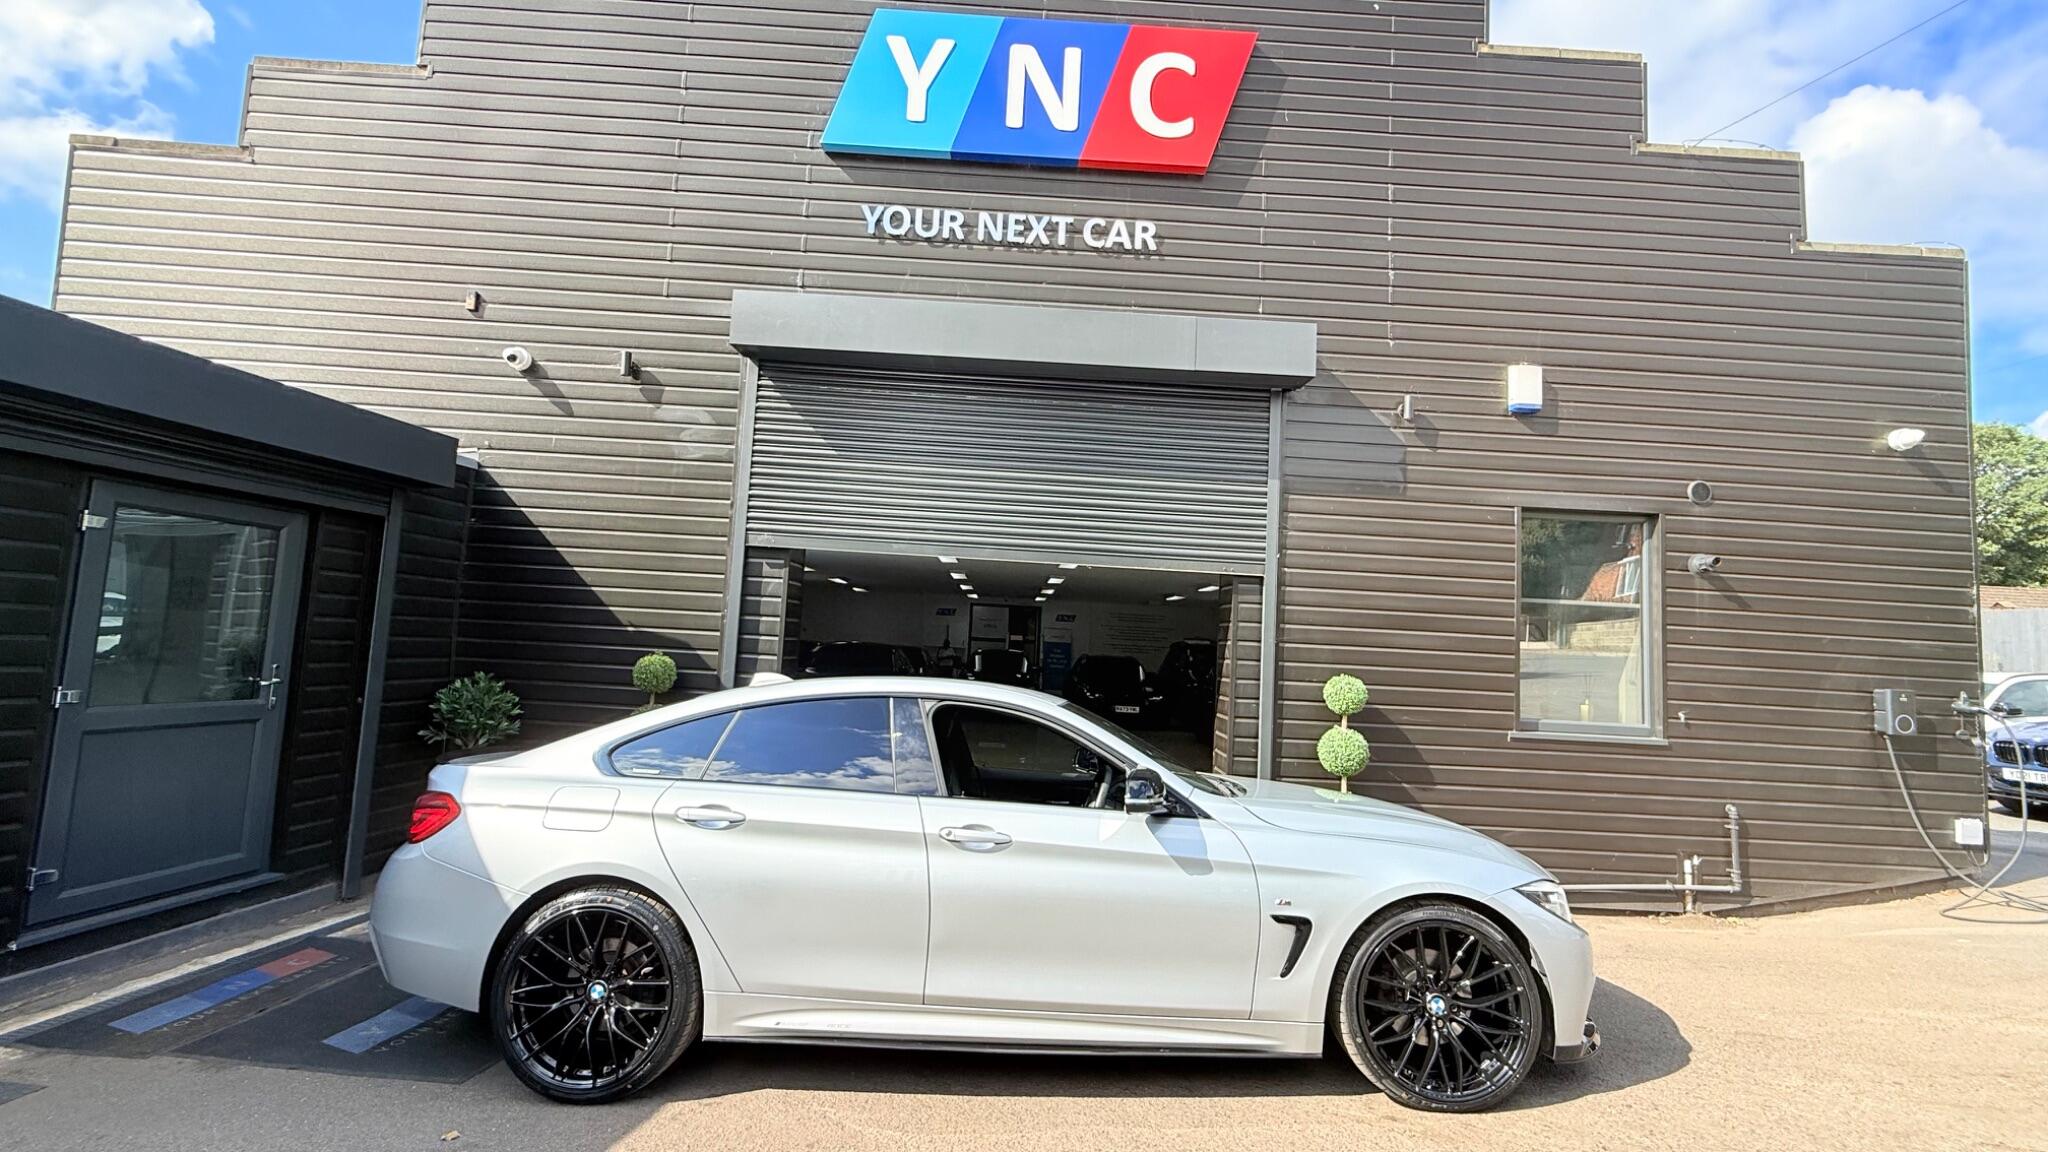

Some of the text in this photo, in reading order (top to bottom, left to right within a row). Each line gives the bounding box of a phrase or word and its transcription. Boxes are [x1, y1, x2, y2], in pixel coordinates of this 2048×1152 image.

[885, 35, 1197, 139] YNC
[861, 204, 1157, 250] YOUR NEXT CAR
[2033, 773, 2048, 782] TB
